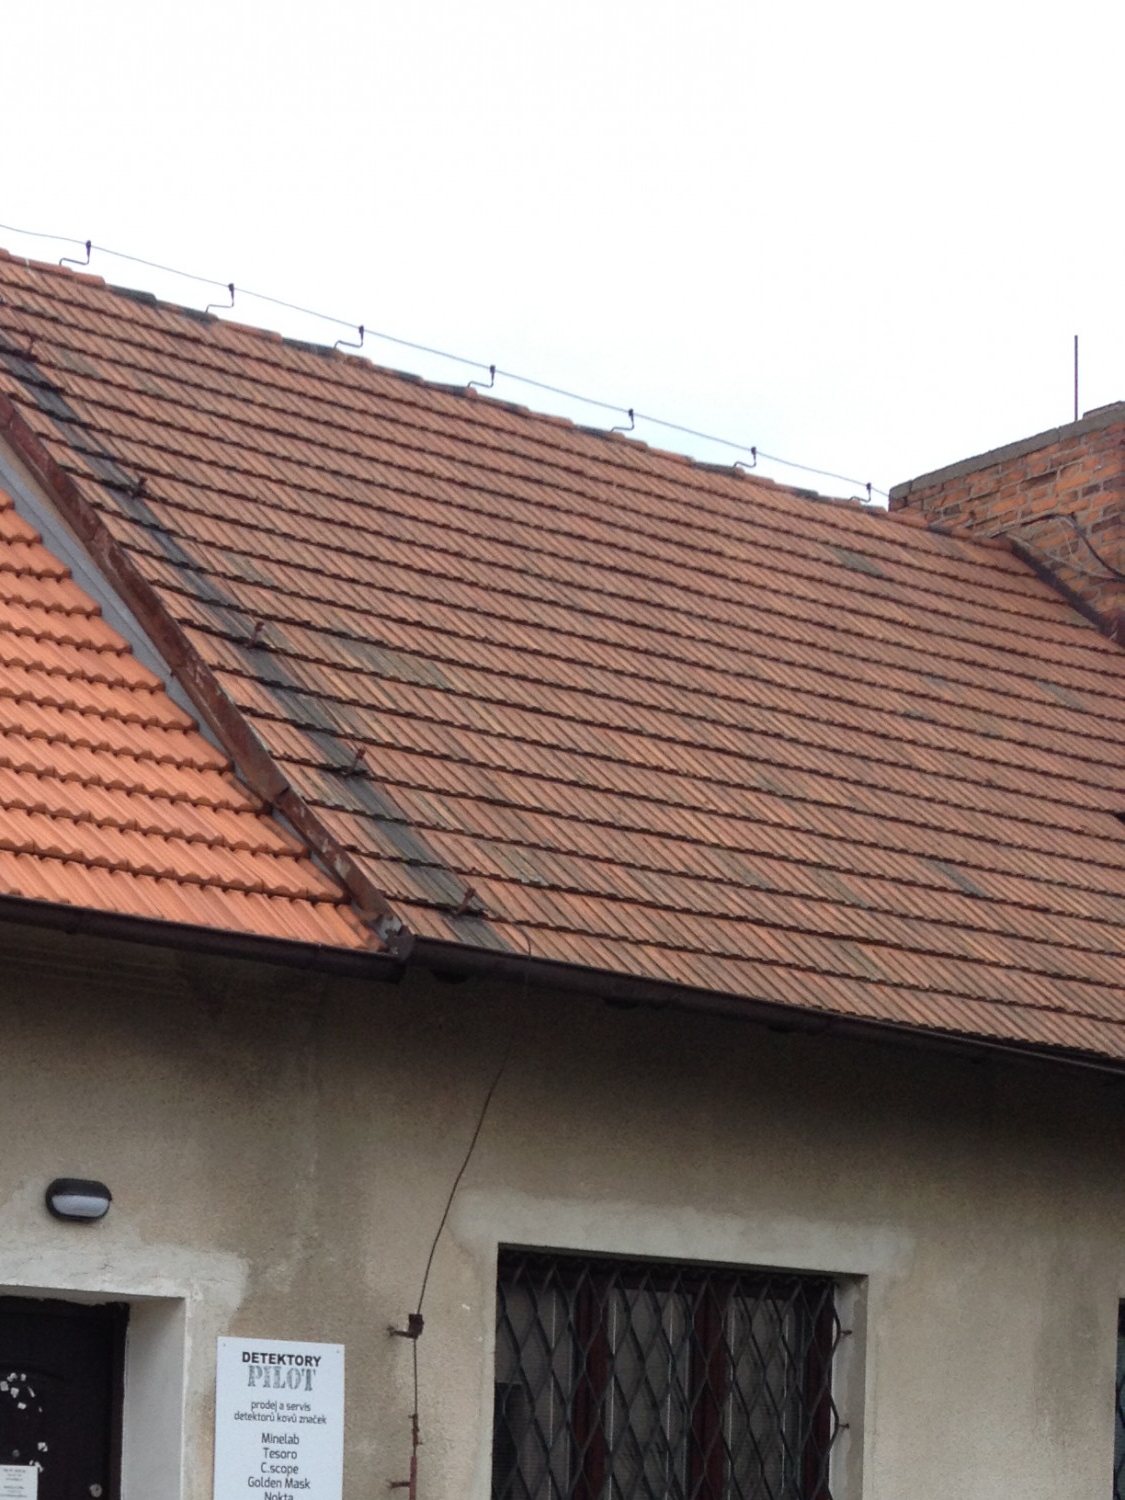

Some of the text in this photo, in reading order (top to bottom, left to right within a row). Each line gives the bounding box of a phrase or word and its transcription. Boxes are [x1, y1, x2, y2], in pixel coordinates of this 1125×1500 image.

[242, 1351, 322, 1367] DETEKTORY
[247, 1365, 317, 1391] PILOT
[251, 1400, 277, 1412] prodej
[286, 1402, 311, 1411] servis
[235, 1411, 275, 1422] detektorů
[299, 1414, 327, 1424] značek
[261, 1432, 300, 1445] Minelab
[263, 1447, 297, 1459] Tesoro
[260, 1462, 299, 1477] C.scope
[247, 1476, 311, 1489] Golden Mask
